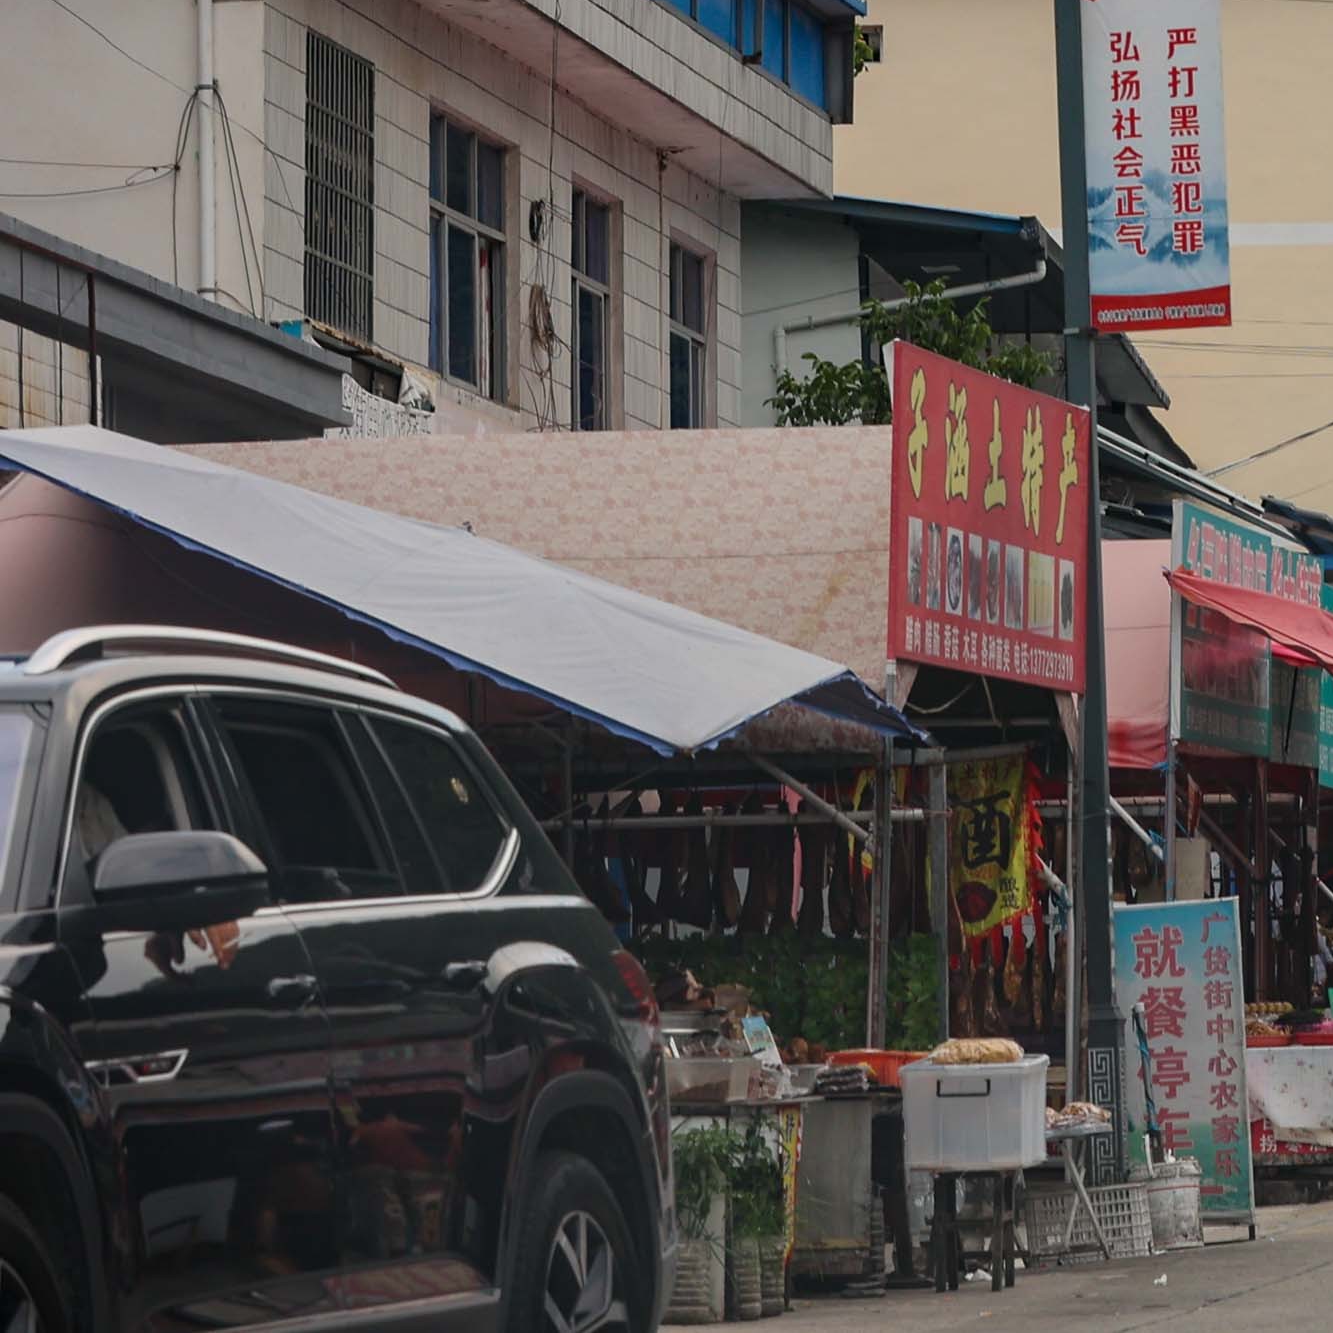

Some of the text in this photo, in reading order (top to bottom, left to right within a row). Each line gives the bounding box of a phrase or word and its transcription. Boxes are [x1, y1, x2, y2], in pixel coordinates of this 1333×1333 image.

[1109, 30, 1148, 257] 弘扬社会正气
[1166, 26, 1205, 255] 严打黑恶犯罪
[1200, 911, 1241, 1179] 广货街中心农家乐
